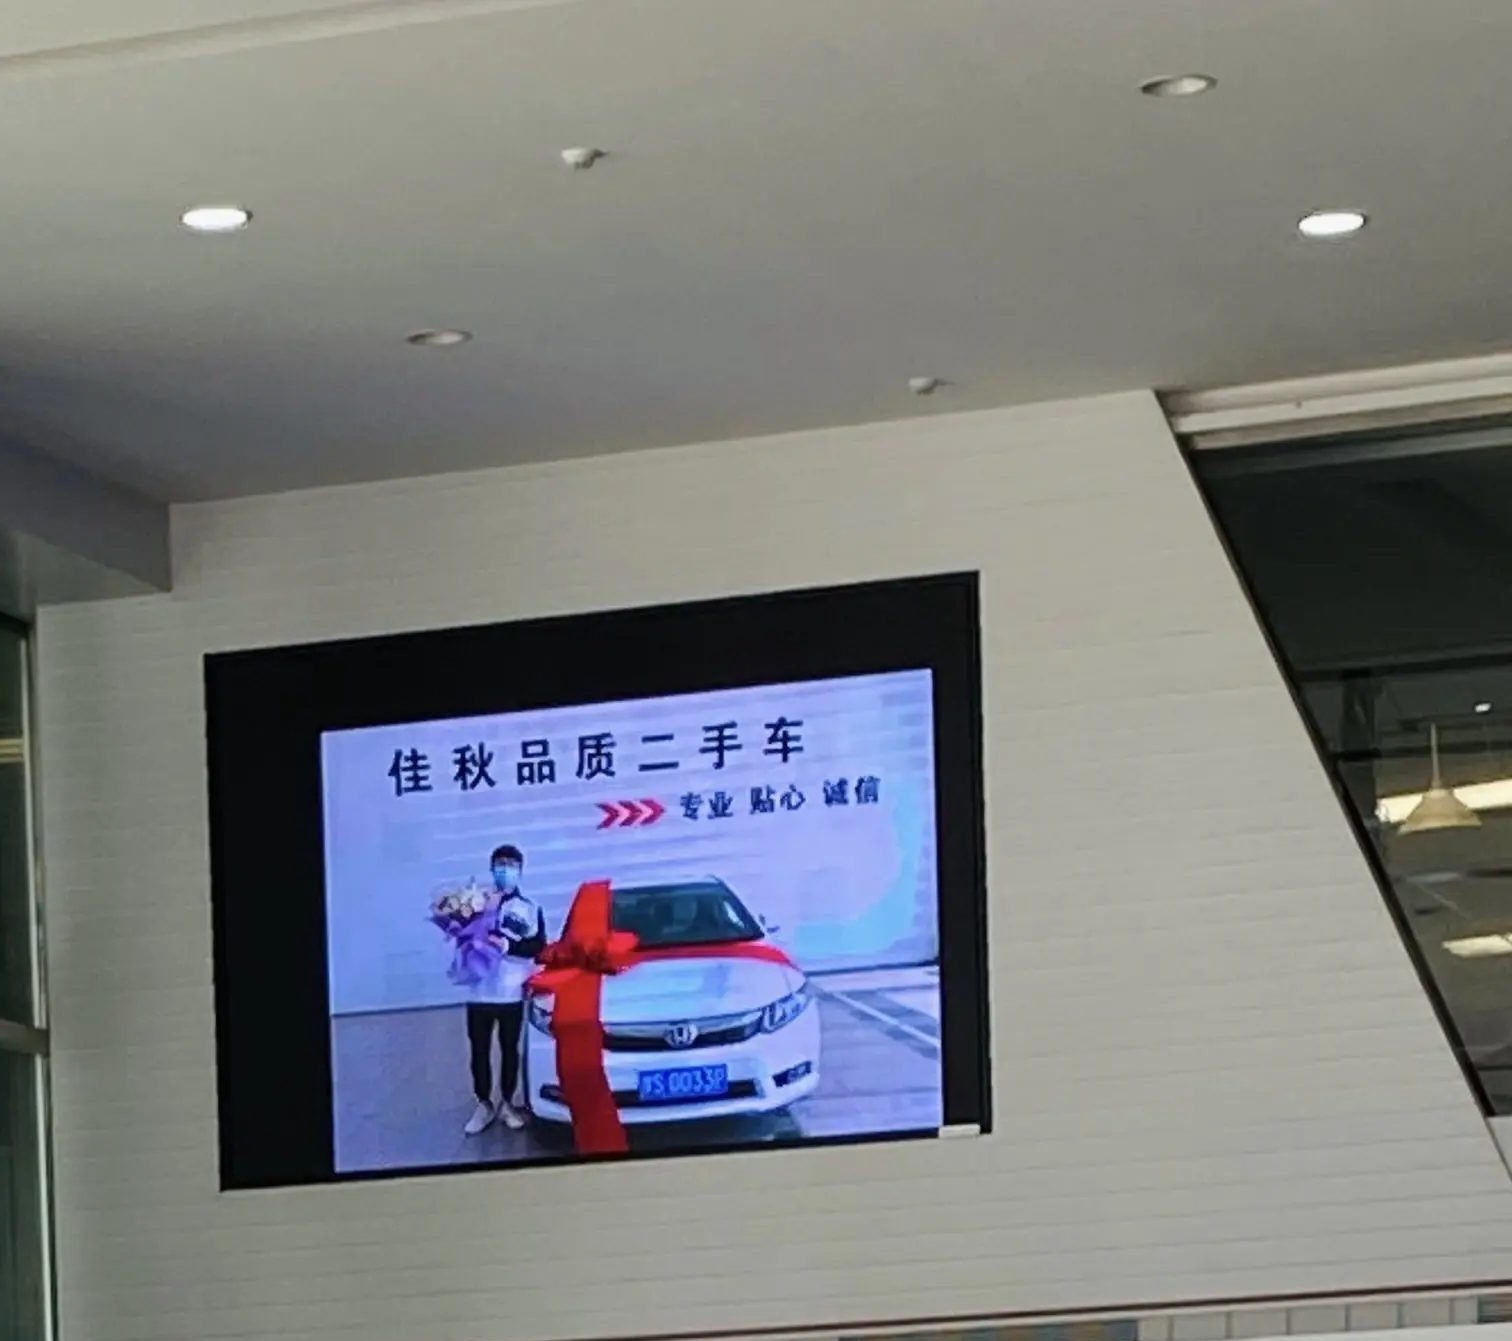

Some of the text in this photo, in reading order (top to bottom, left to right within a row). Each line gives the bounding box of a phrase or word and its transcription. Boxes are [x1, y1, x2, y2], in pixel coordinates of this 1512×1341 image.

[388, 716, 805, 796] 佳秋品质二手车
[679, 775, 881, 821] 专业 贴心 诚信
